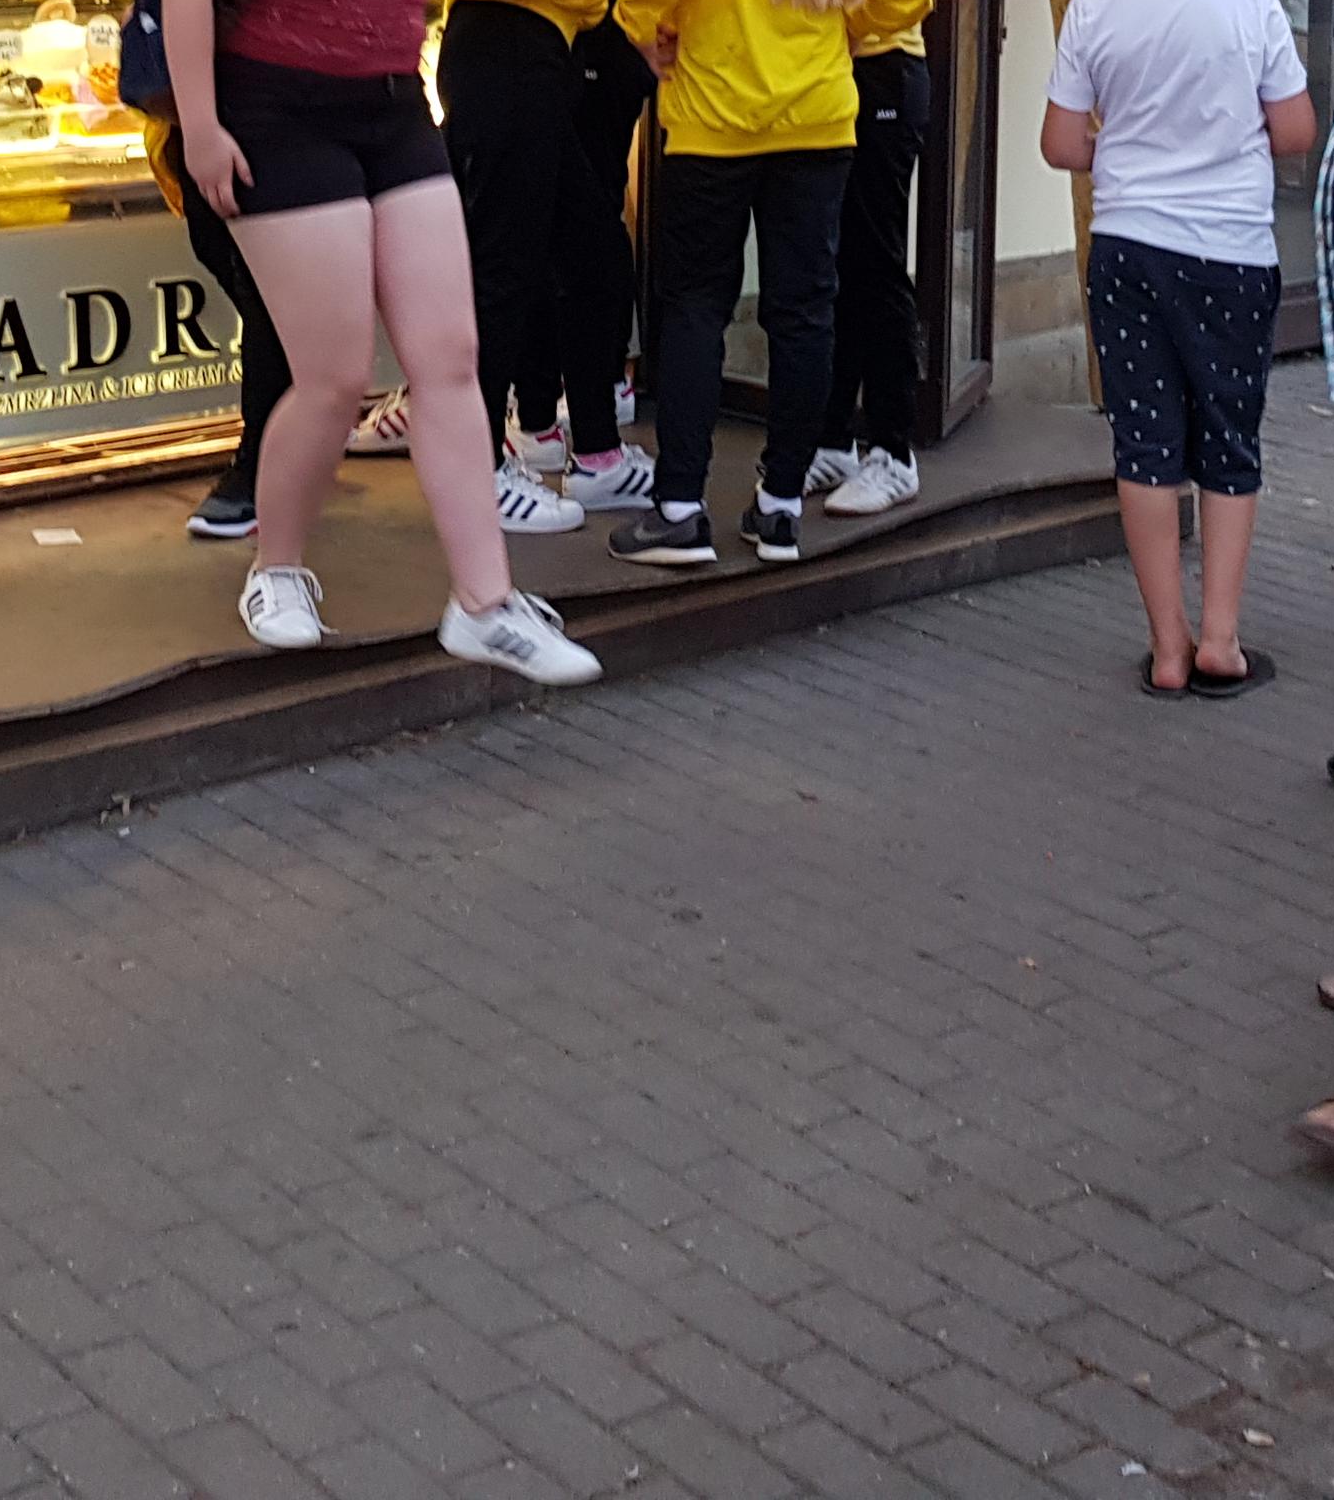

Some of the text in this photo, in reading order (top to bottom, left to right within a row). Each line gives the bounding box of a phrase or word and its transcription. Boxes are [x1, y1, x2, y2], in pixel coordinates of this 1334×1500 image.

[101, 376, 119, 400] &
[122, 371, 156, 397] ICE
[157, 362, 225, 393] CREAM
